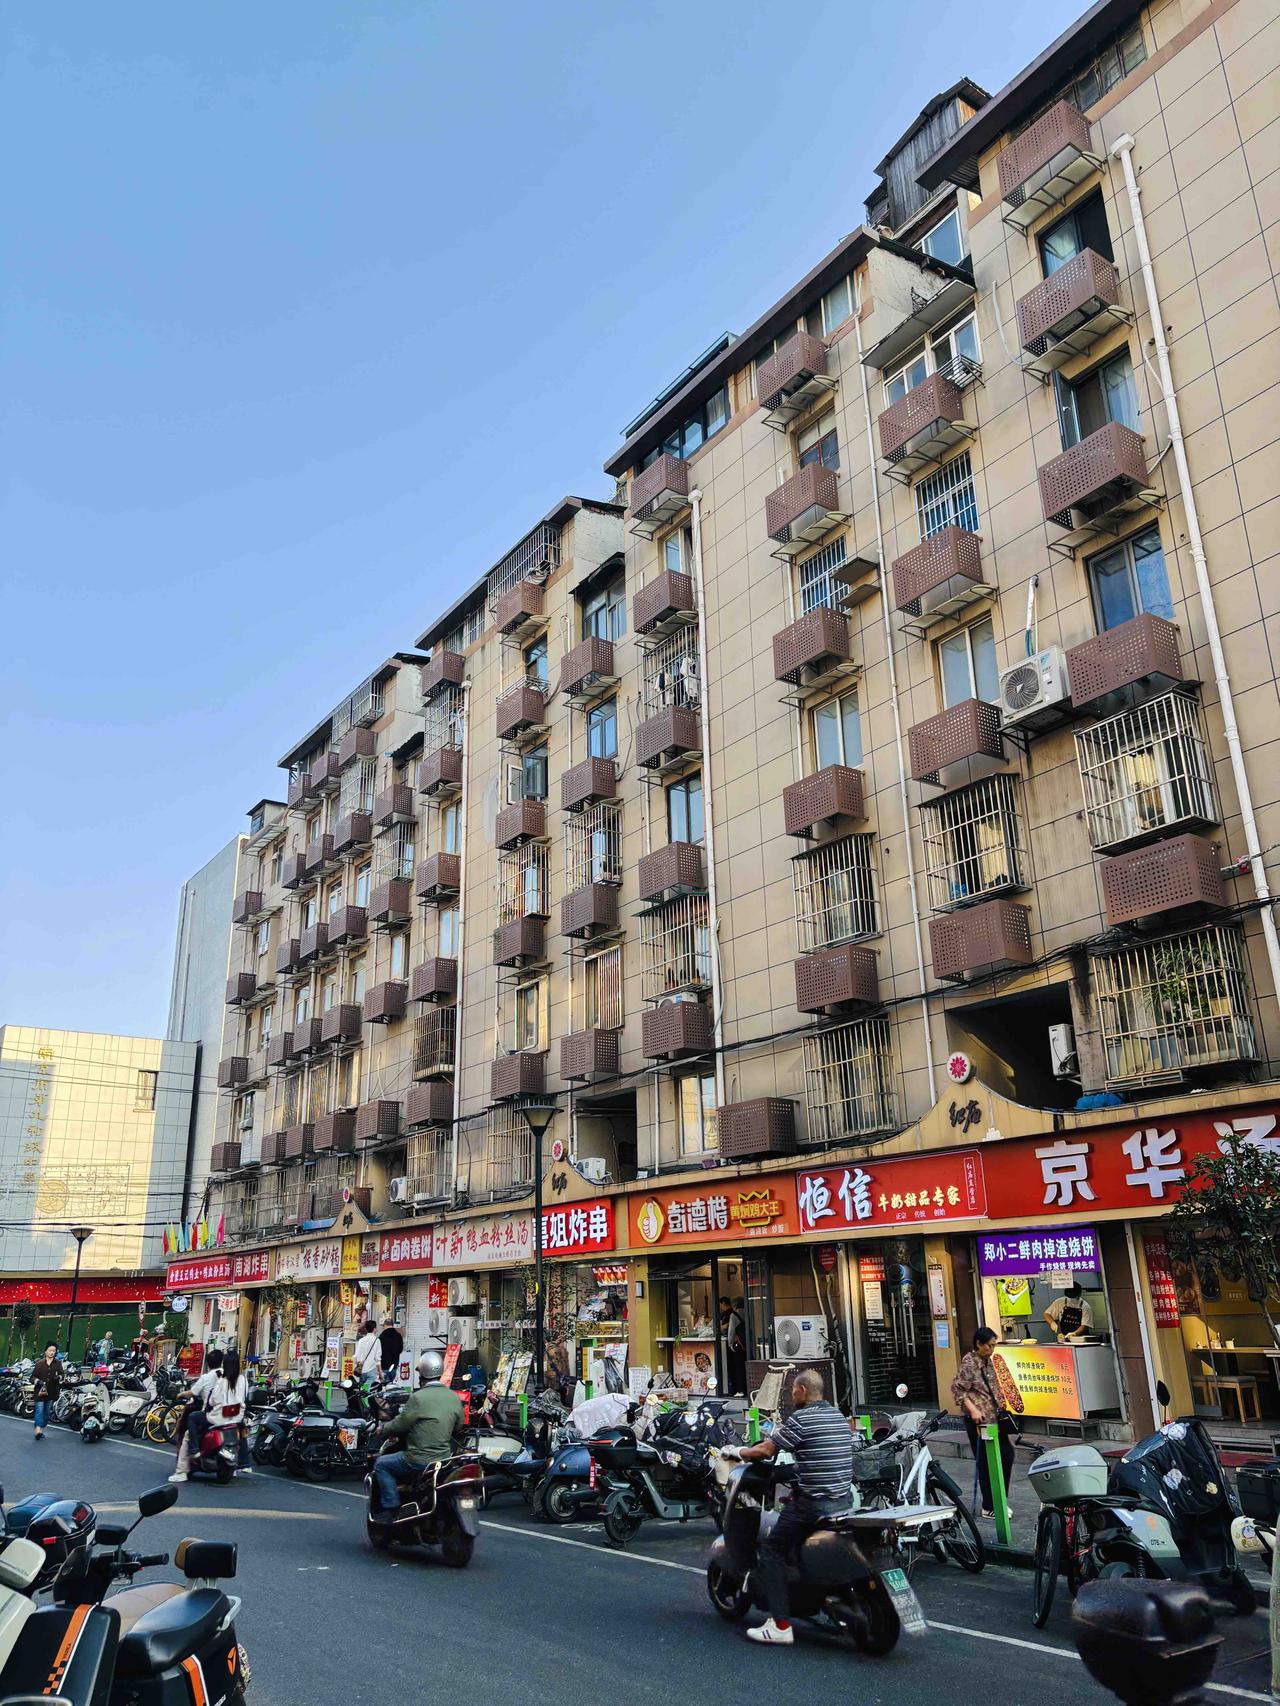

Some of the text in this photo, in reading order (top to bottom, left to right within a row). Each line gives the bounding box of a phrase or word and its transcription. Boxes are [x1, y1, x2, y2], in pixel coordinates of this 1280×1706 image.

[730, 1201, 780, 1219] 黄焖鸡大王
[800, 1168, 873, 1228] 恒信
[877, 1185, 961, 1212] 牛奶甜品专家
[667, 1195, 728, 1234] 彭德楷
[390, 1234, 432, 1262] 卤肉卷饼
[435, 1219, 529, 1263] 叶新鸭血粉丝汤
[984, 1236, 1095, 1262] 郑小二鲜肉掉渣烧饼
